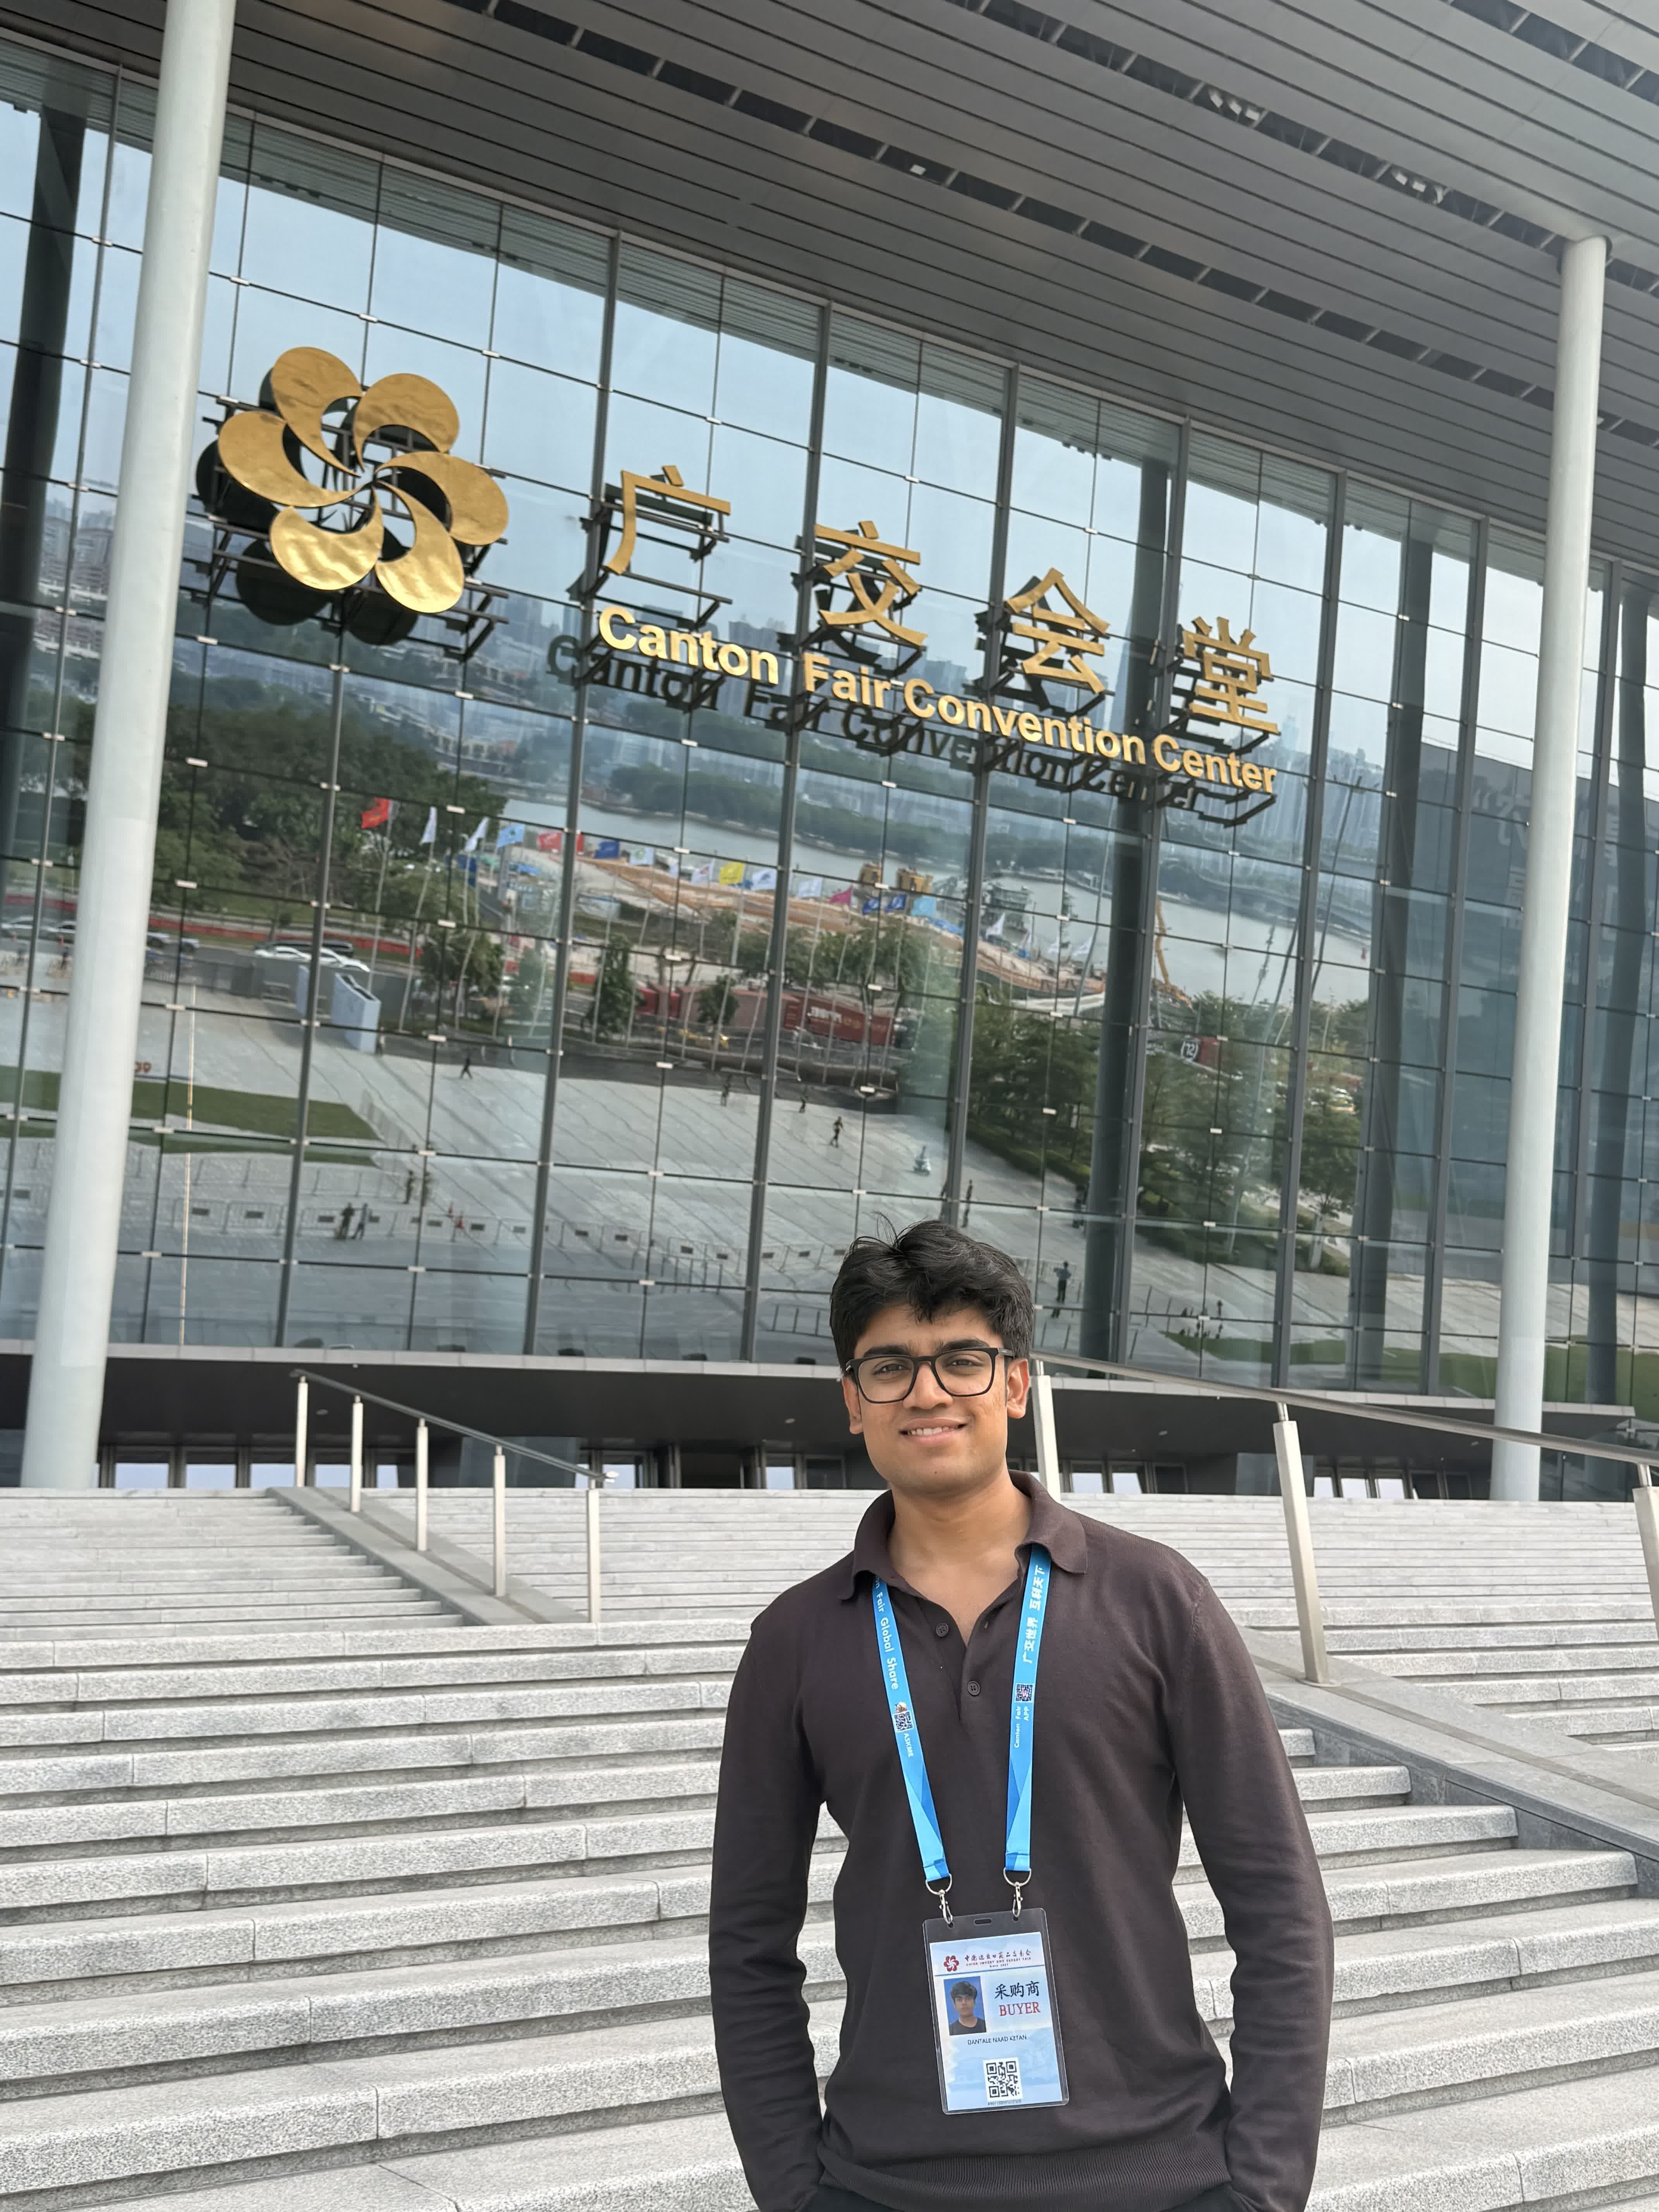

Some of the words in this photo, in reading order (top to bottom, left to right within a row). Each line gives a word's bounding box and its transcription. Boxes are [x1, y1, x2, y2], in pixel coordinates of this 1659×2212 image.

[604, 465, 1280, 735] 广交会堂
[599, 606, 779, 685] Canton
[804, 652, 891, 708] Fair
[904, 678, 1146, 765] Convention
[1154, 734, 1277, 793] Center
[876, 1592, 885, 1612] Fair
[880, 1617, 895, 1652] Global
[1022, 1617, 1038, 1664] 广交世界
[886, 1657, 898, 1690] Share
[994, 1981, 1040, 2000] 采购商
[999, 2002, 1041, 2016] BUYER
